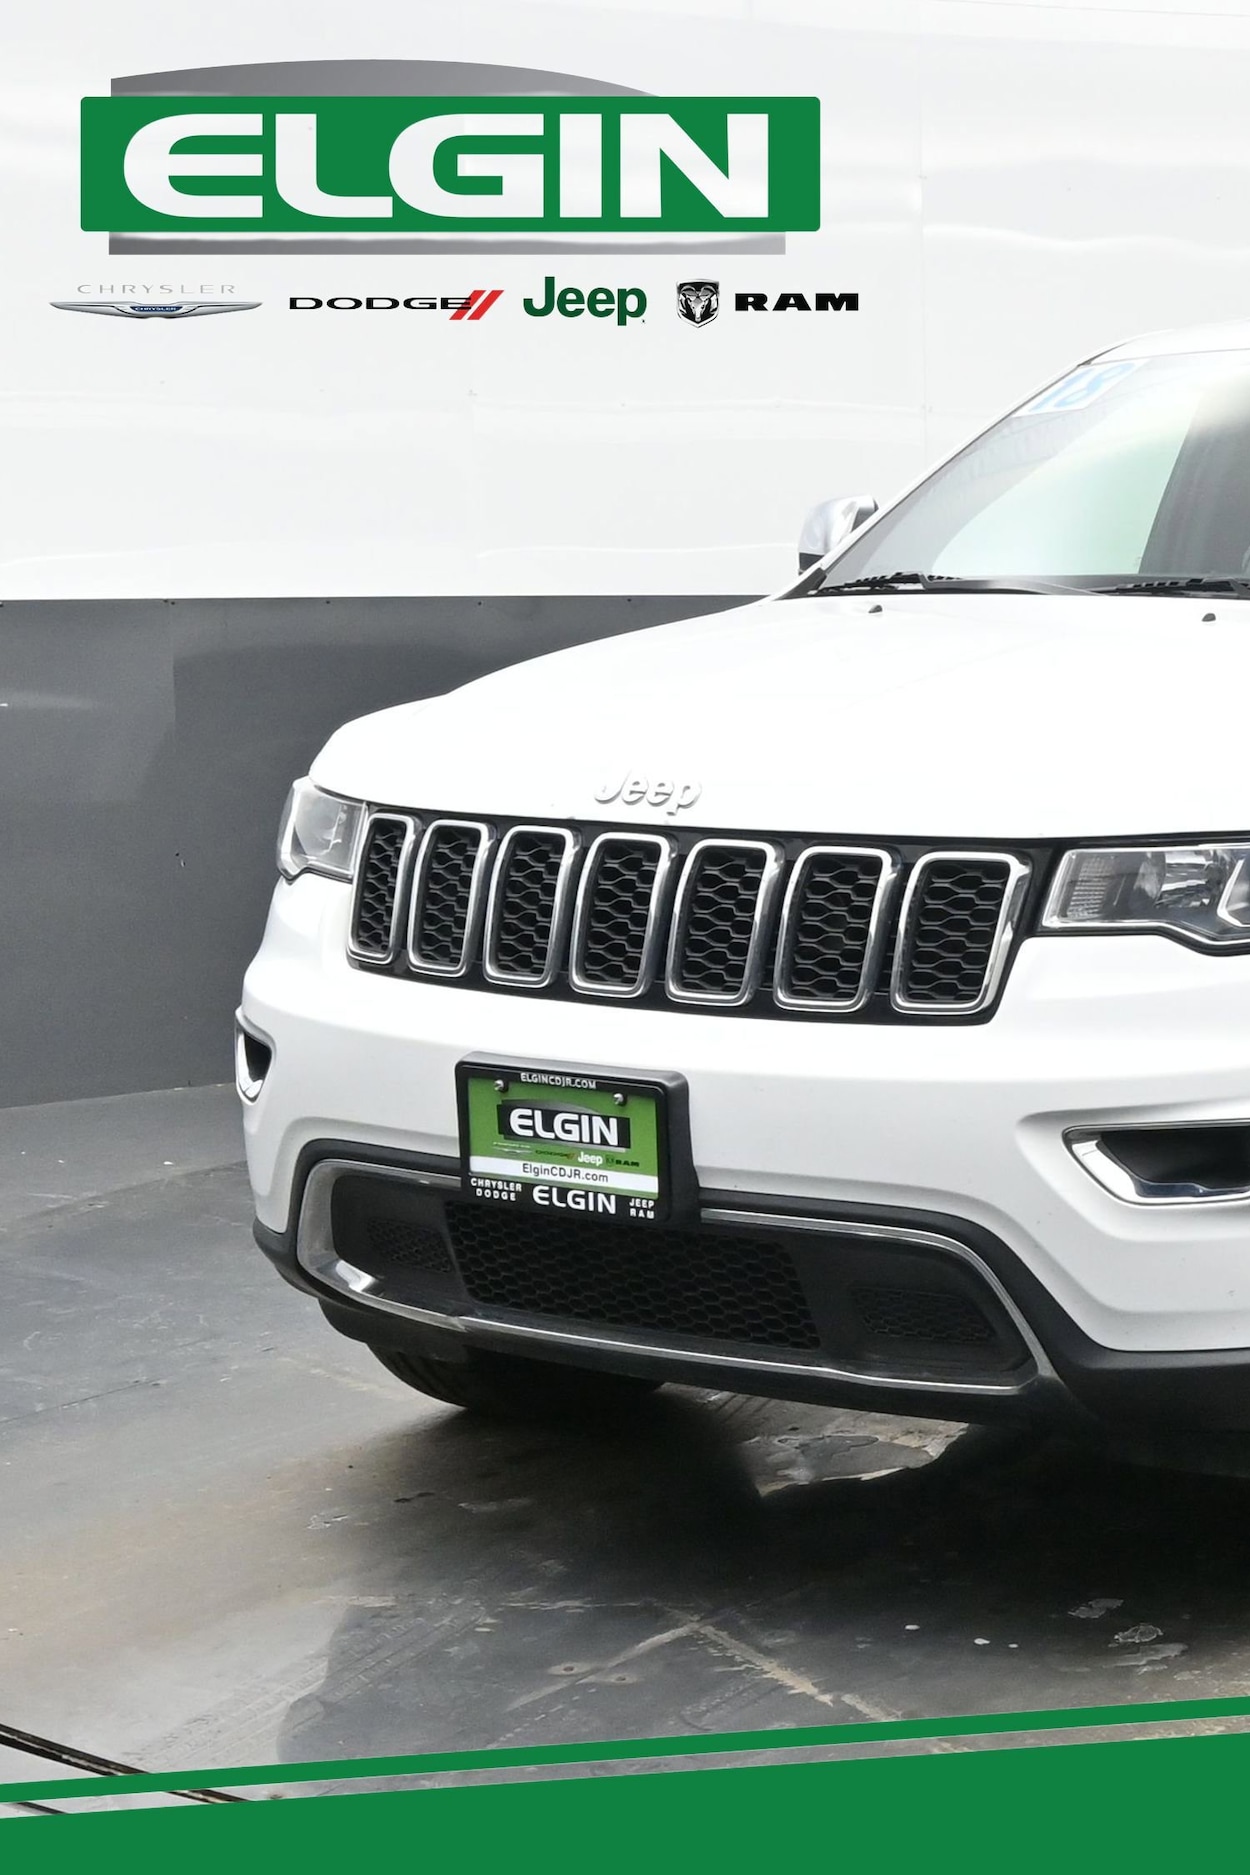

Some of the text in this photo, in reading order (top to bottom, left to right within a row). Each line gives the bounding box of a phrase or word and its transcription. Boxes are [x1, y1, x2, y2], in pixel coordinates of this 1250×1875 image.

[593, 768, 702, 816] Jeep
[520, 1072, 597, 1089] ELGINCDJR.COM
[510, 1108, 619, 1146] ELGIN
[577, 1151, 604, 1167] Jeep
[522, 1163, 609, 1183] ElginCDJR.com
[470, 1177, 523, 1192] CHRYSLER
[475, 1188, 517, 1202] DODGE
[532, 1185, 617, 1215] ELGIN
[628, 1197, 655, 1208] JEEP
[629, 1208, 655, 1220] RAM
